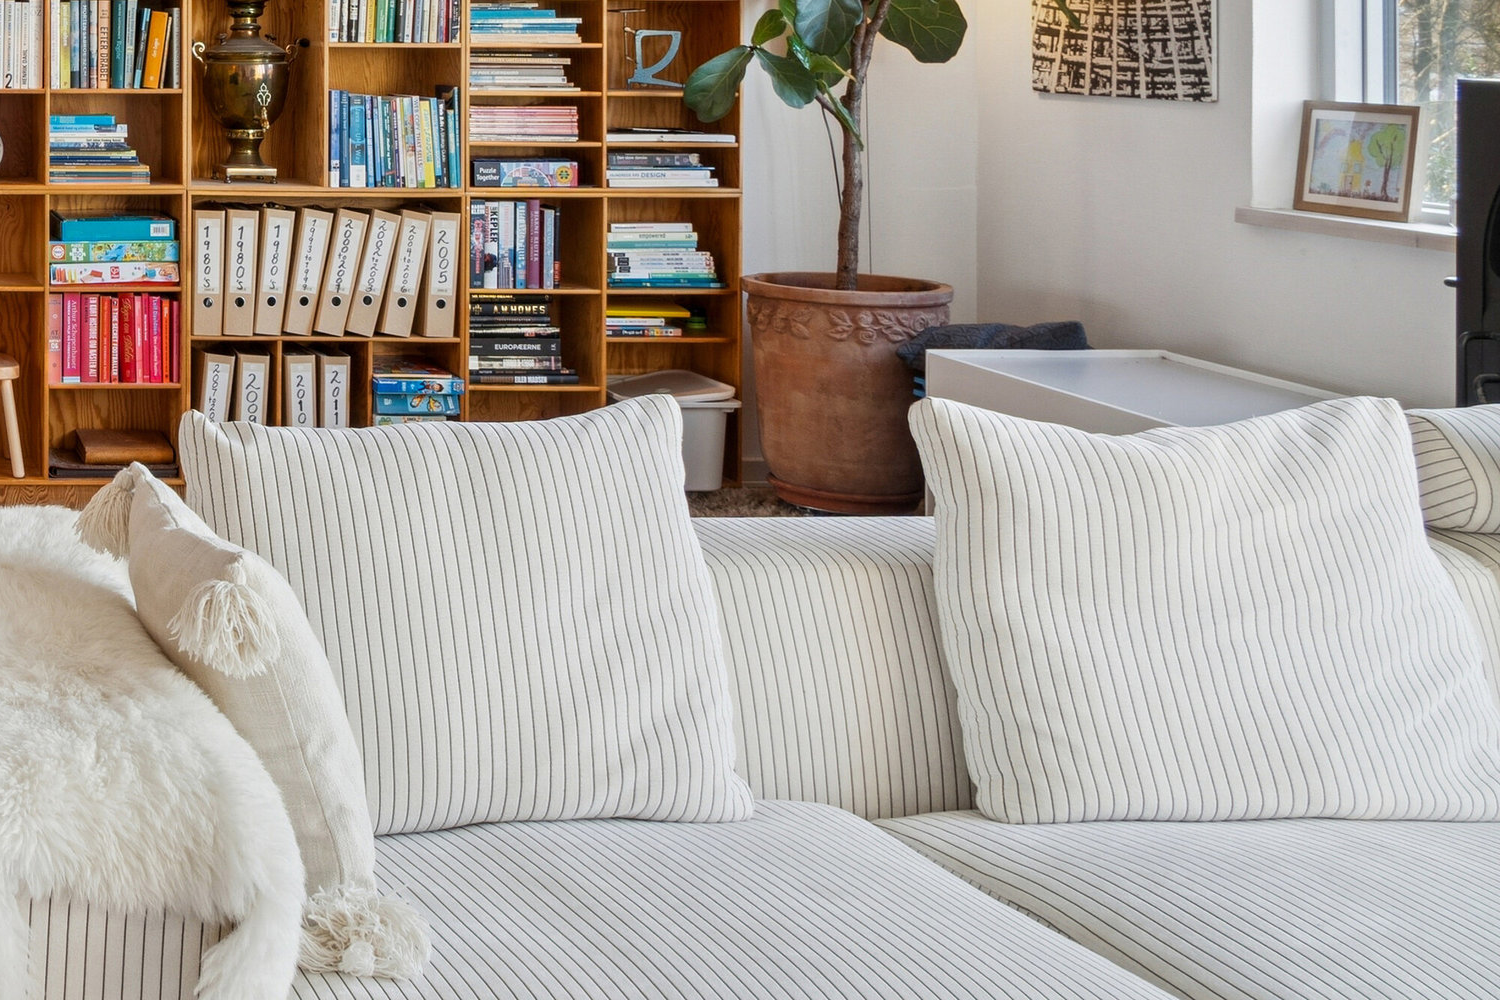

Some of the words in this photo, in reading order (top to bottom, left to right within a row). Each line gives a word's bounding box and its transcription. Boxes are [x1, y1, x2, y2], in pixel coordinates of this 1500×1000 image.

[100, 26, 108, 50] EFTER
[100, 53, 108, 83] DRABET
[5, 73, 13, 89] 2
[476, 174, 500, 182] Together
[479, 167, 497, 175] Puzzle
[340, 219, 354, 253] 2000
[373, 220, 387, 257] 2002
[490, 211, 498, 243] KEPLER
[406, 225, 417, 258] 2004
[437, 229, 449, 284] 2005
[70, 300, 78, 322] Arthur
[89, 304, 97, 317] KORT
[510, 305, 546, 314] HOMES
[89, 318, 97, 340] HISTORIE
[70, 323, 78, 369] Schopenhauer
[89, 340, 97, 348] OM
[89, 369, 97, 377] ALT
[296, 374, 307, 424] 2010
[330, 370, 341, 425] 2011
